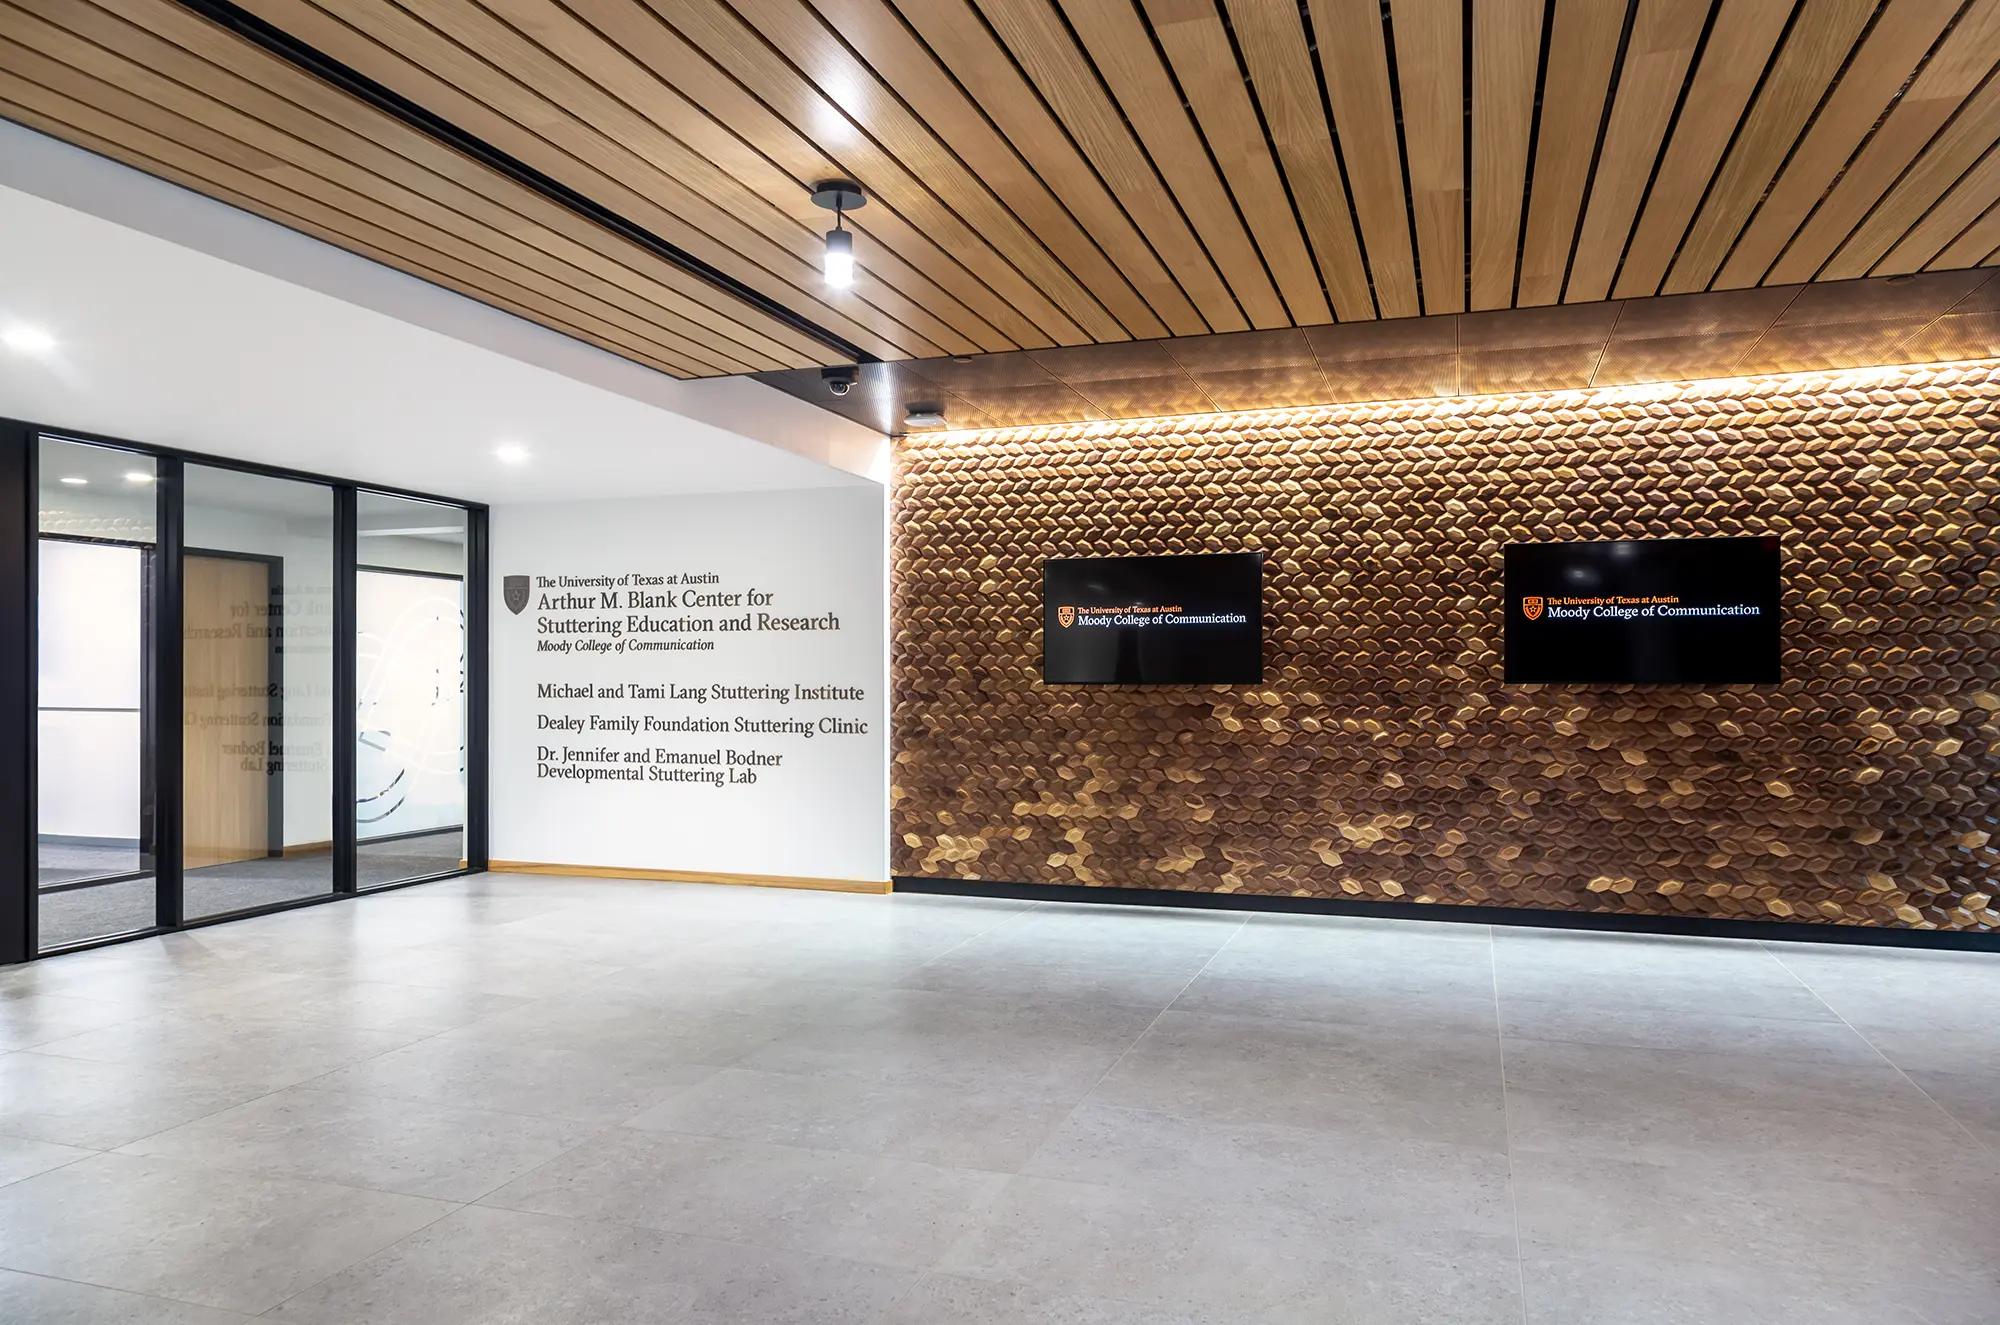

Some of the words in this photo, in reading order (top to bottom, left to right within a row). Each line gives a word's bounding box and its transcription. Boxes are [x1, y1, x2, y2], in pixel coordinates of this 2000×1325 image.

[536, 576, 556, 587] The
[559, 575, 615, 589] University
[617, 574, 629, 586] of
[632, 574, 664, 585] Texas
[667, 575, 677, 584] at
[681, 572, 719, 584] Austin
[538, 593, 596, 610] Arthur
[601, 592, 622, 609] M.
[628, 591, 677, 608] Blank
[682, 590, 742, 607] Center
[747, 588, 773, 606] for
[1563, 597, 1605, 606] University
[1606, 596, 1617, 604] of
[1616, 596, 1640, 604] Texas
[1651, 596, 1679, 604] Austin
[1091, 606, 1124, 616] University
[1124, 605, 1132, 613] of
[1132, 605, 1152, 613] Texas
[1160, 605, 1182, 613] Austin
[1548, 607, 1590, 620] Moody
[1593, 605, 1638, 619] College
[1641, 605, 1655, 616] of
[1657, 604, 1760, 616] Communication
[538, 617, 622, 638] Stuttering
[627, 615, 714, 632] Education
[719, 613, 752, 631] and
[758, 612, 840, 631] Research
[1078, 615, 1112, 627] Moody
[1114, 615, 1150, 627] College
[1152, 614, 1163, 624] of
[1165, 613, 1246, 624] Communication
[537, 640, 572, 654] Moody
[575, 640, 612, 654] College
[615, 639, 627, 654] of
[629, 639, 714, 651] Communication
[538, 684, 593, 698] Michael
[598, 684, 624, 698] and
[628, 684, 665, 698] Tami
[670, 684, 707, 704] Lang
[711, 684, 790, 704] Stuttering
[795, 684, 864, 700] Institute
[538, 715, 585, 734] Dealey
[590, 715, 639, 735] Family
[644, 716, 729, 732] Foundation
[734, 717, 814, 738] Stuttering
[819, 718, 868, 734] Clinic
[538, 746, 558, 762] Dr.
[562, 747, 619, 763] Jennifer
[624, 748, 650, 763] and
[655, 748, 720, 765] Emanuel
[726, 750, 782, 766] Bodner
[537, 763, 644, 783] Developmental
[649, 766, 724, 787] Stuttering
[729, 768, 756, 784] Lab
